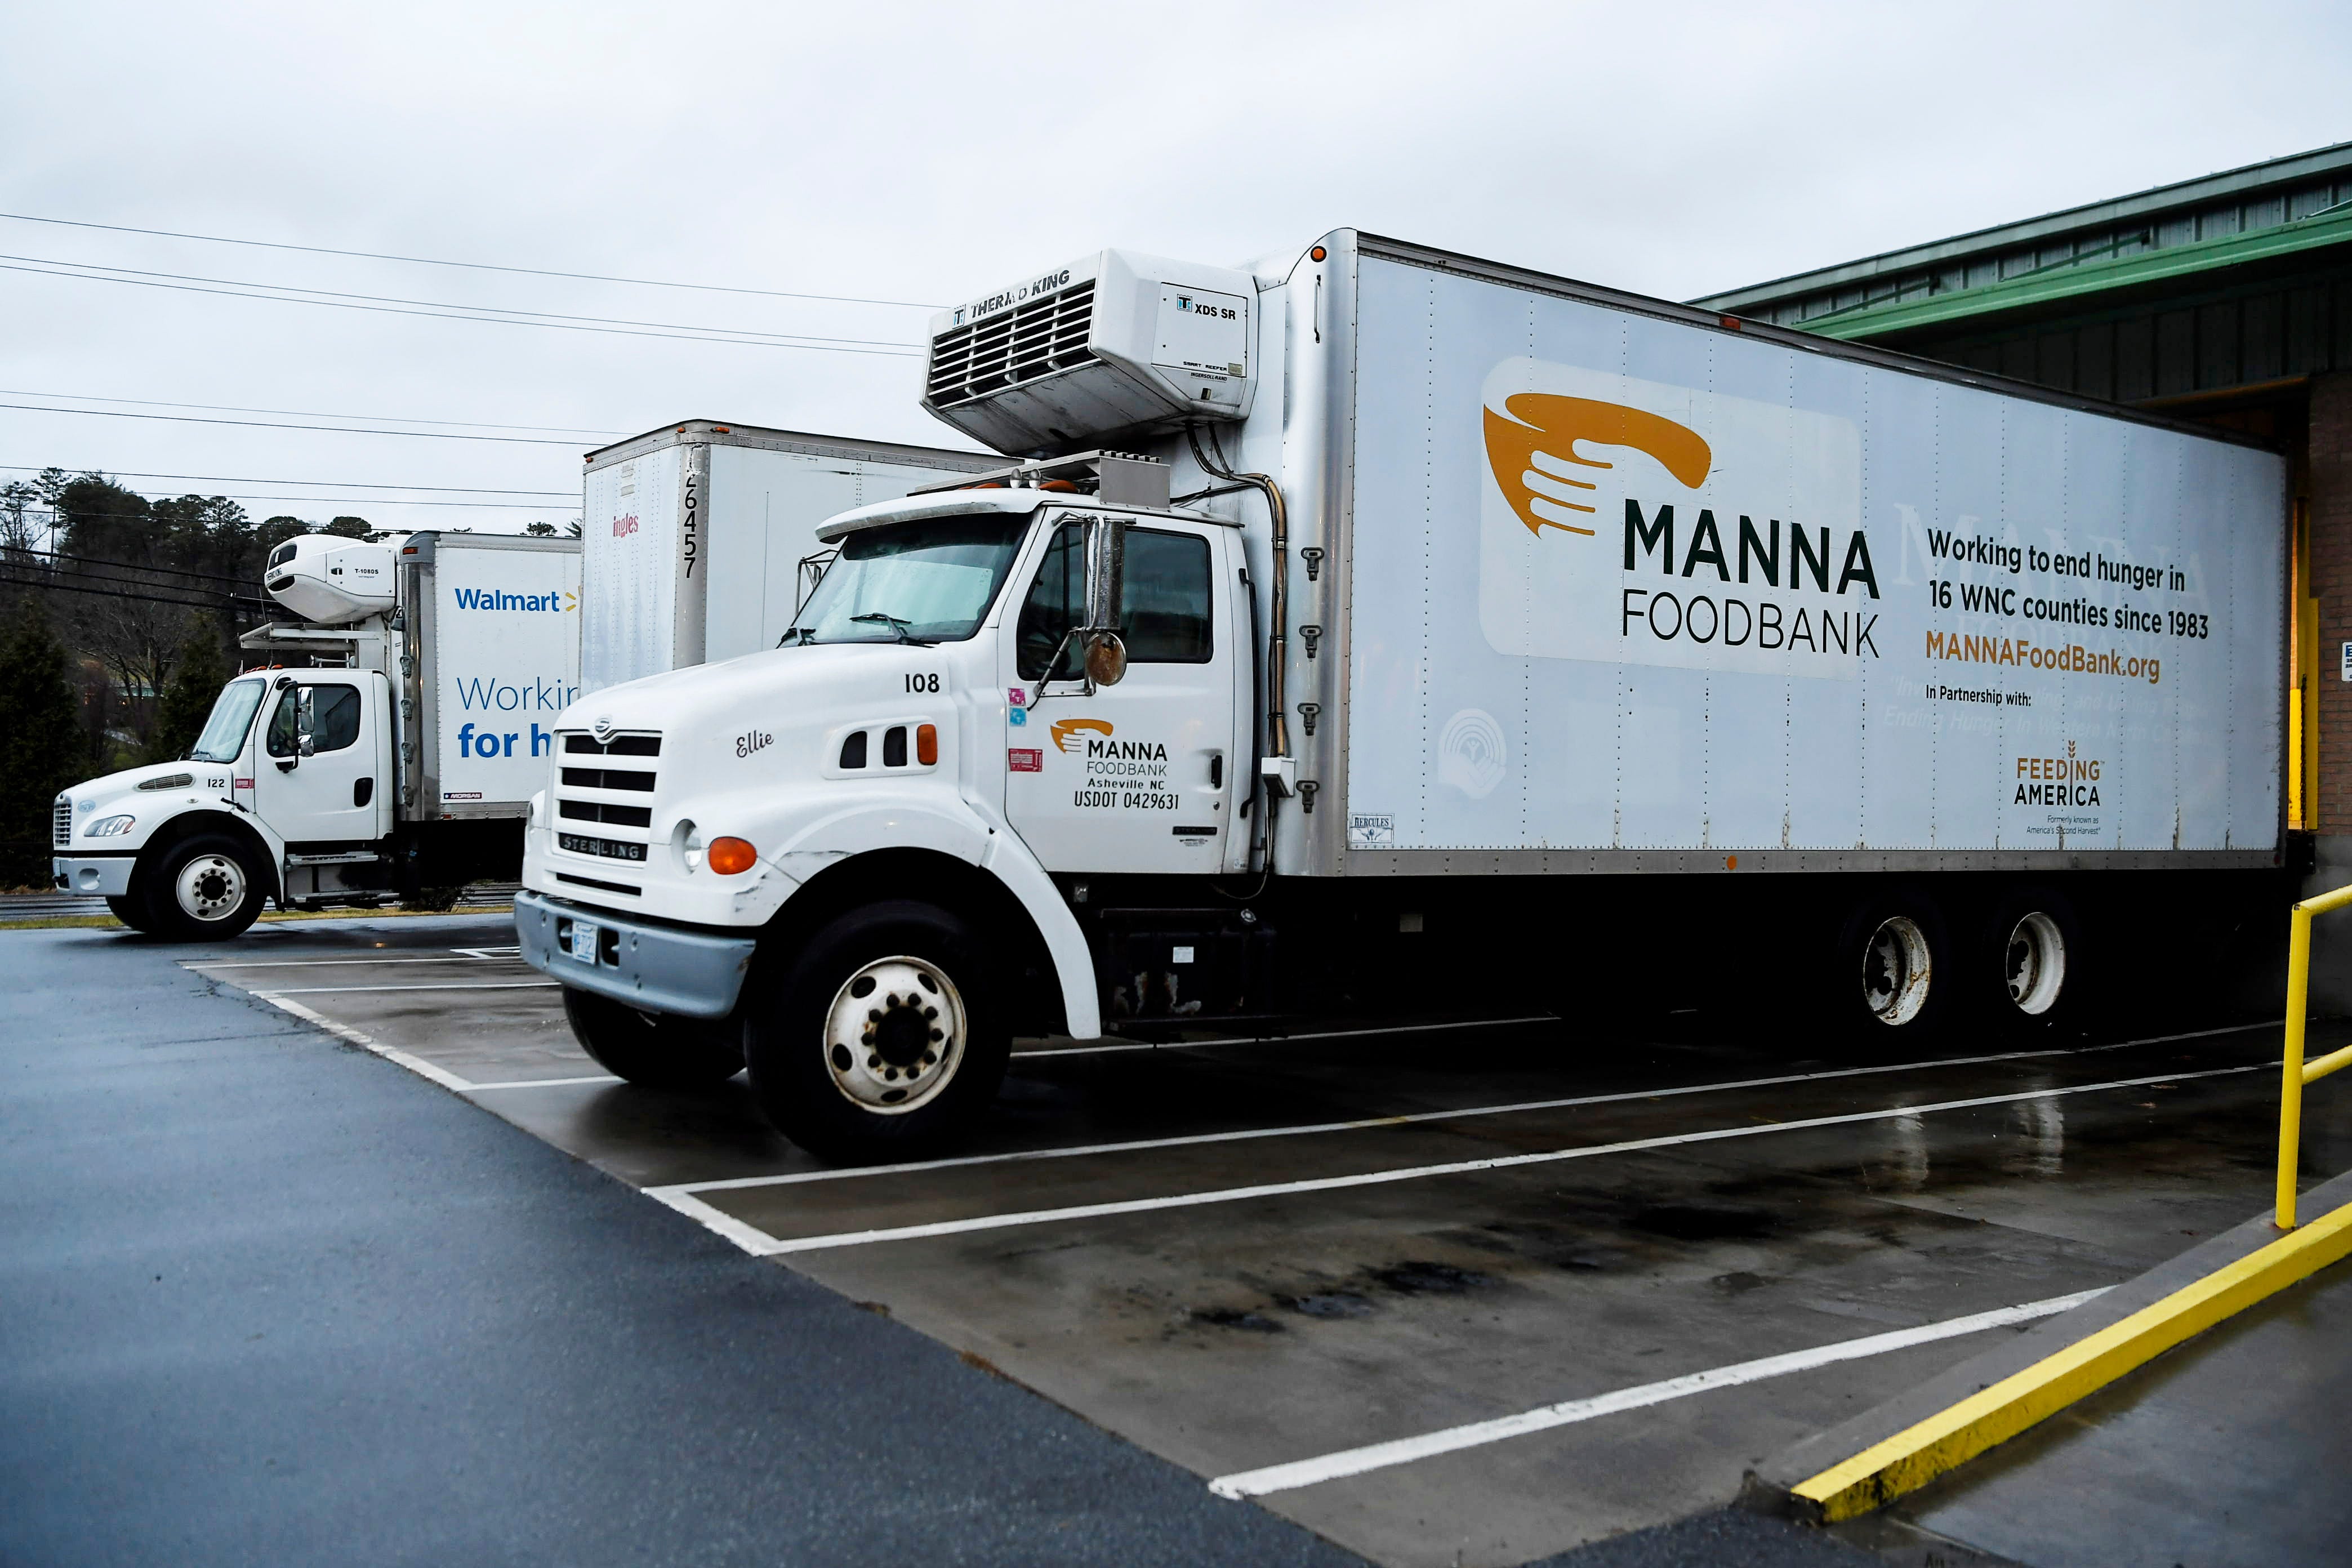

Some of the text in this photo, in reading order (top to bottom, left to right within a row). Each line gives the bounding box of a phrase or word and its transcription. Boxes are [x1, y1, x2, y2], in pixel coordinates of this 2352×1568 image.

[1032, 270, 1070, 296] KING
[1195, 304, 1236, 320] XDS SR
[613, 513, 639, 538] ingles
[1624, 498, 1880, 599] MANNA
[1927, 528, 2185, 592] Working to end hunger in
[455, 588, 559, 612] Walmart
[1929, 580, 2208, 640] 16 WNC counties since 1983
[1622, 589, 1879, 658] FOODBANK
[1926, 630, 2160, 684] MANNAFoodBank.org
[906, 673, 939, 693] 108
[1926, 684, 1936, 700] In
[1940, 685, 2002, 707] Partnership
[2006, 692, 2032, 707] with:
[458, 723, 518, 758] for
[737, 730, 774, 758] Ellie
[1088, 740, 1168, 761] MANNA
[1087, 761, 1167, 777] FOODBANK
[2017, 758, 2100, 783] FEEDING
[208, 778, 225, 787] 122
[1088, 778, 1165, 790] Asheville NC
[1075, 791, 1179, 809] USDOT 0429631
[2014, 784, 2100, 807] AMERICA
[1355, 817, 1389, 827] HERCULES
[2047, 815, 2072, 825] Formerly
[564, 836, 639, 858] STERLING
